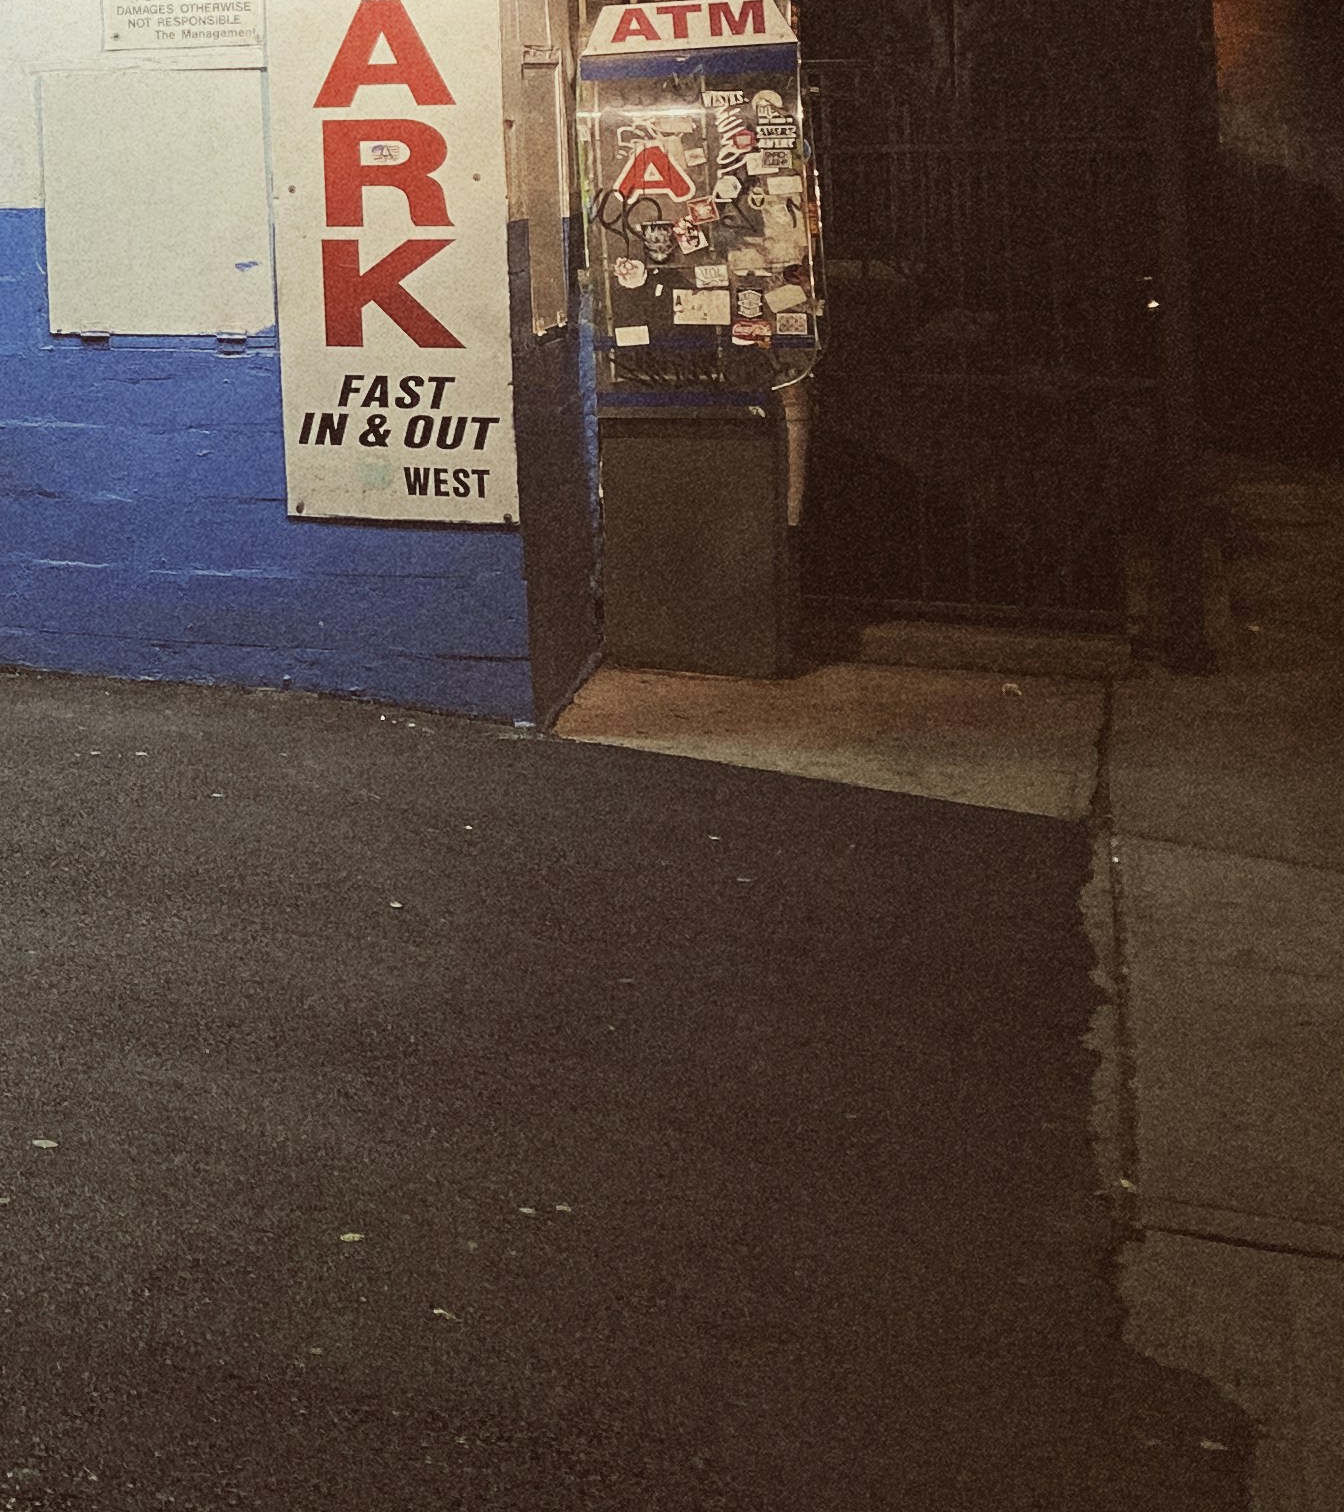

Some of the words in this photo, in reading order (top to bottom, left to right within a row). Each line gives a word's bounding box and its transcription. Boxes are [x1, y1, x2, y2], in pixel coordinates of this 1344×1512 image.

[117, 4, 174, 16] DAMAGES
[180, 1, 251, 13] OTHERWISE
[128, 17, 151, 28] NOT
[158, 15, 241, 27] RESPONSIBLE
[611, 0, 766, 43] ATM
[155, 30, 176, 39] The
[181, 28, 256, 40] Management
[338, 374, 456, 410] FAST
[298, 412, 349, 446] IN
[359, 413, 392, 448] &
[403, 414, 500, 451] OUT
[404, 466, 490, 499] WEST
